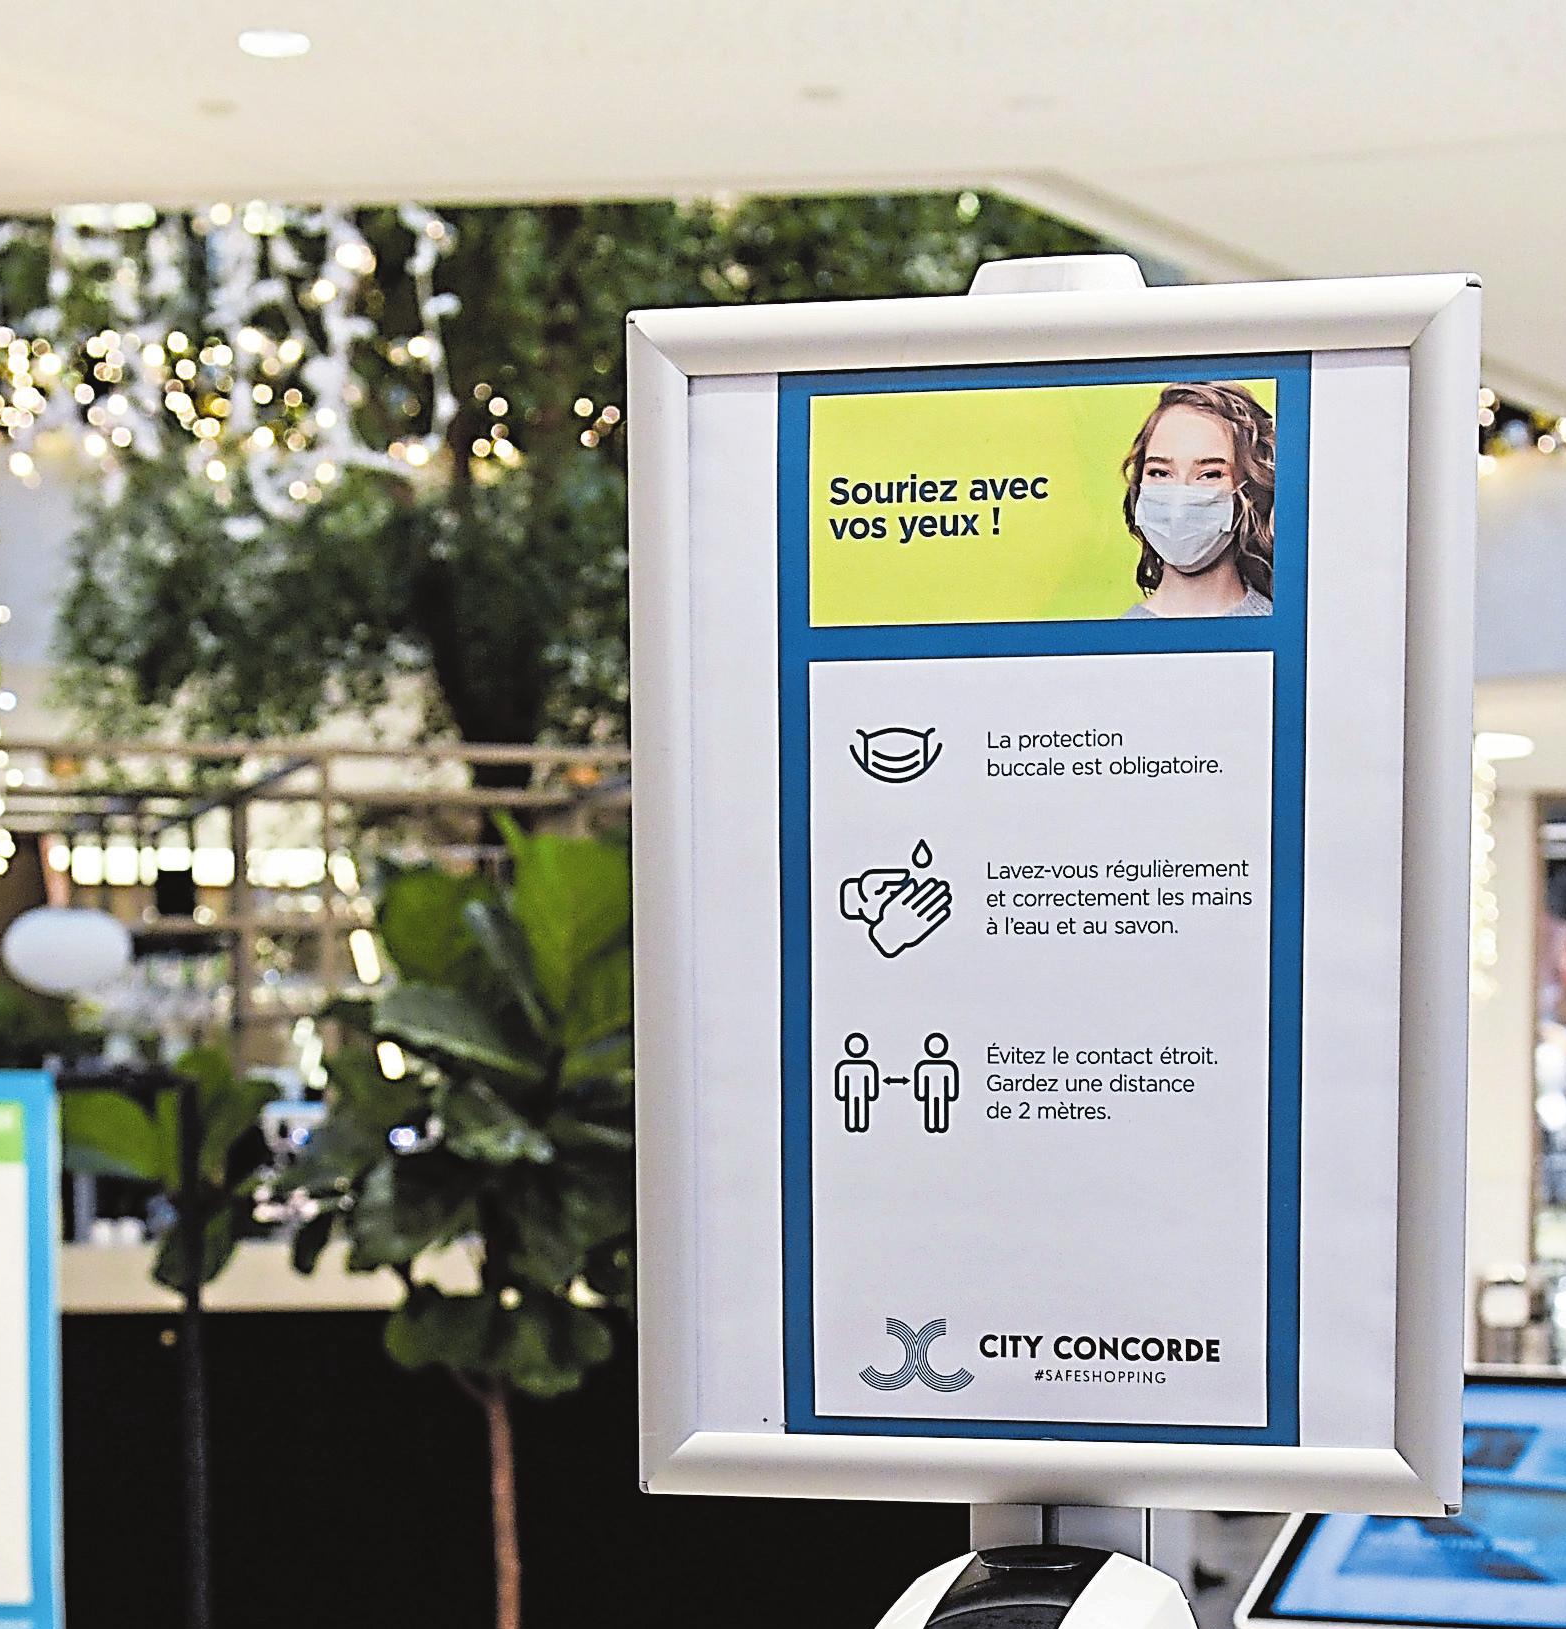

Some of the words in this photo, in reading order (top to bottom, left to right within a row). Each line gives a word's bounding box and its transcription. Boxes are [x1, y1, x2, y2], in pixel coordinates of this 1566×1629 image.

[829, 473, 958, 506] Souriez
[969, 476, 1049, 501] avec
[829, 515, 887, 540] vos
[898, 513, 980, 544] yeux
[992, 506, 1000, 535] !
[987, 731, 1011, 749] La
[1018, 729, 1123, 752] protection
[987, 757, 1065, 777] buccale
[1072, 757, 1103, 776] est
[1109, 755, 1224, 778] obligatoire.
[987, 861, 1099, 881] Lavez-vous
[1106, 859, 1250, 882] régulièrement
[986, 889, 1006, 908] et
[1012, 888, 1151, 908] correctement
[1157, 887, 1185, 906] les
[1191, 886, 1253, 906] mains
[986, 916, 998, 936] à
[1056, 917, 1077, 935] et
[1082, 920, 1107, 935] au
[1114, 920, 1179, 935] savon.
[987, 1042, 1046, 1065] Évitez
[1052, 1045, 1070, 1065] le
[1075, 1047, 1154, 1065] contact
[1159, 1042, 1219, 1065] étroit.
[986, 1073, 1059, 1093] Gardez
[1065, 1078, 1103, 1093] une
[1109, 1073, 1195, 1093] distance
[986, 1100, 1012, 1120] de
[1018, 1101, 1031, 1120] 2
[1037, 1101, 1112, 1120] mètres.
[979, 1333, 1044, 1359] CITY
[1053, 1335, 1221, 1363] CONCORDE
[1034, 1369, 1167, 1386] #SAFESHOPPING
